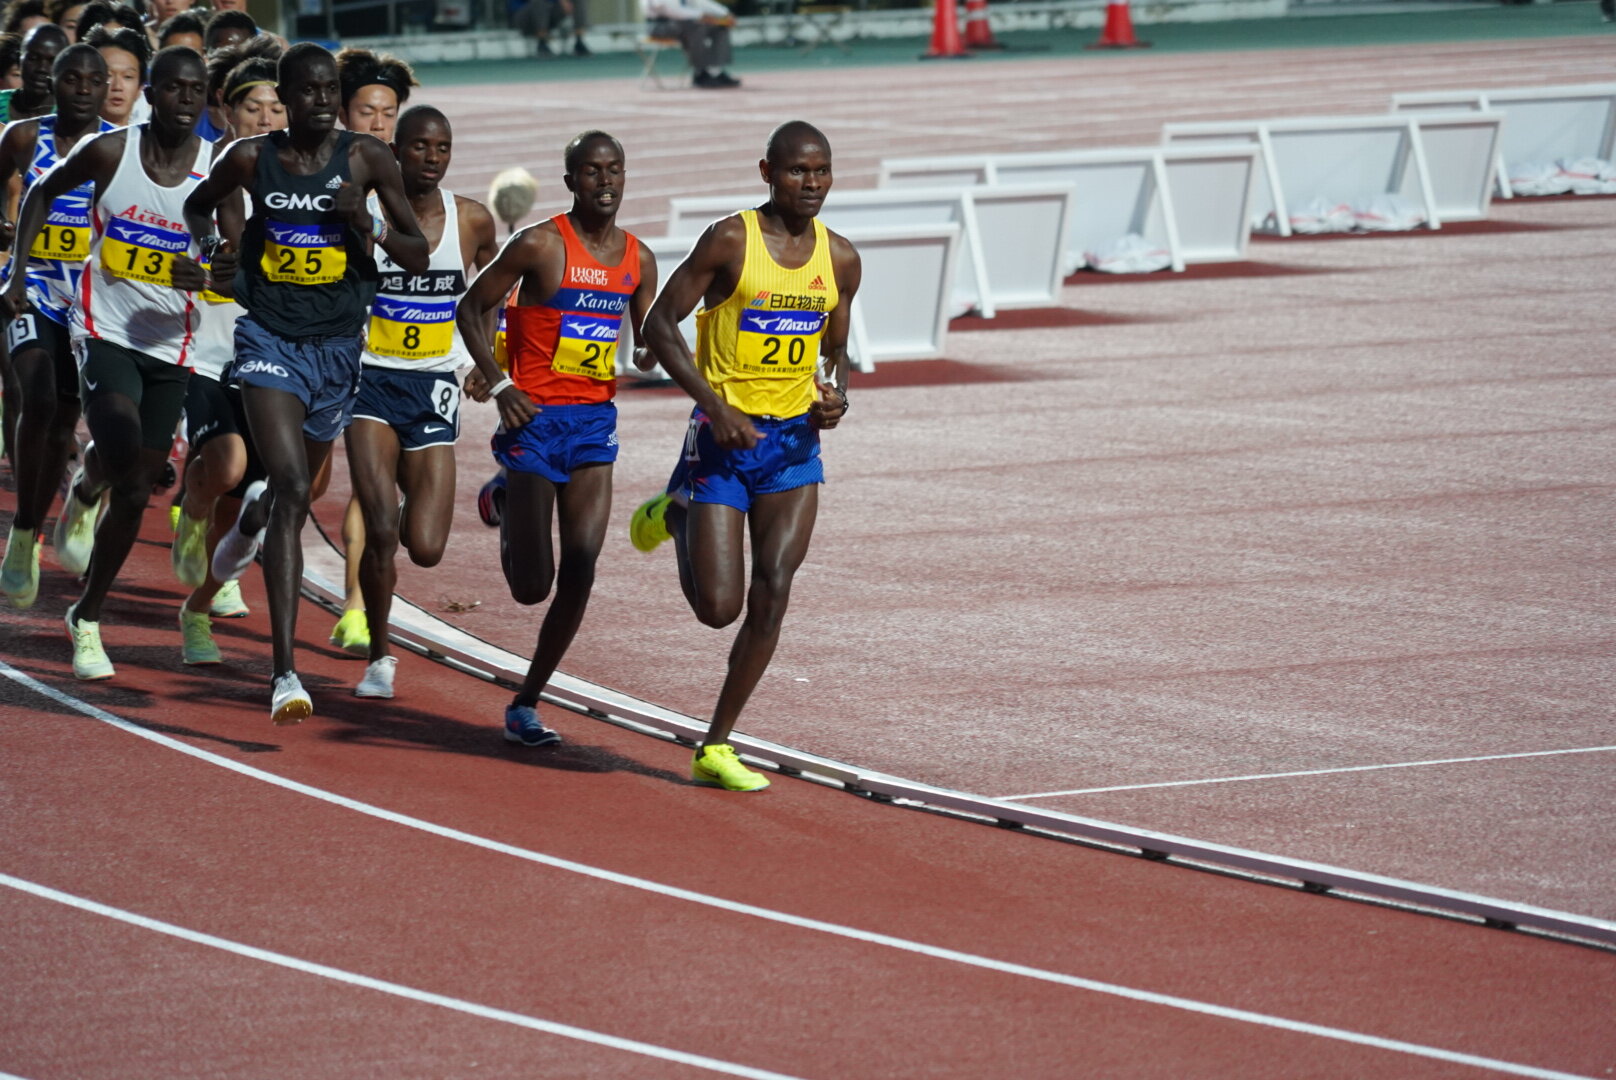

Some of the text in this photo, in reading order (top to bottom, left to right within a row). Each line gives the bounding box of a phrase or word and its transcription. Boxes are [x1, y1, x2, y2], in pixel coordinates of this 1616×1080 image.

[265, 192, 336, 212] GMO
[47, 212, 88, 224] Mizun
[40, 226, 76, 252] 19
[126, 247, 163, 275] 13
[278, 248, 322, 275] 25
[380, 275, 455, 292] 旭化成
[770, 293, 827, 311] 日立物流
[402, 325, 420, 349] 8
[760, 337, 805, 365] 20
[237, 360, 289, 378] GMO
[438, 386, 452, 416] 8
